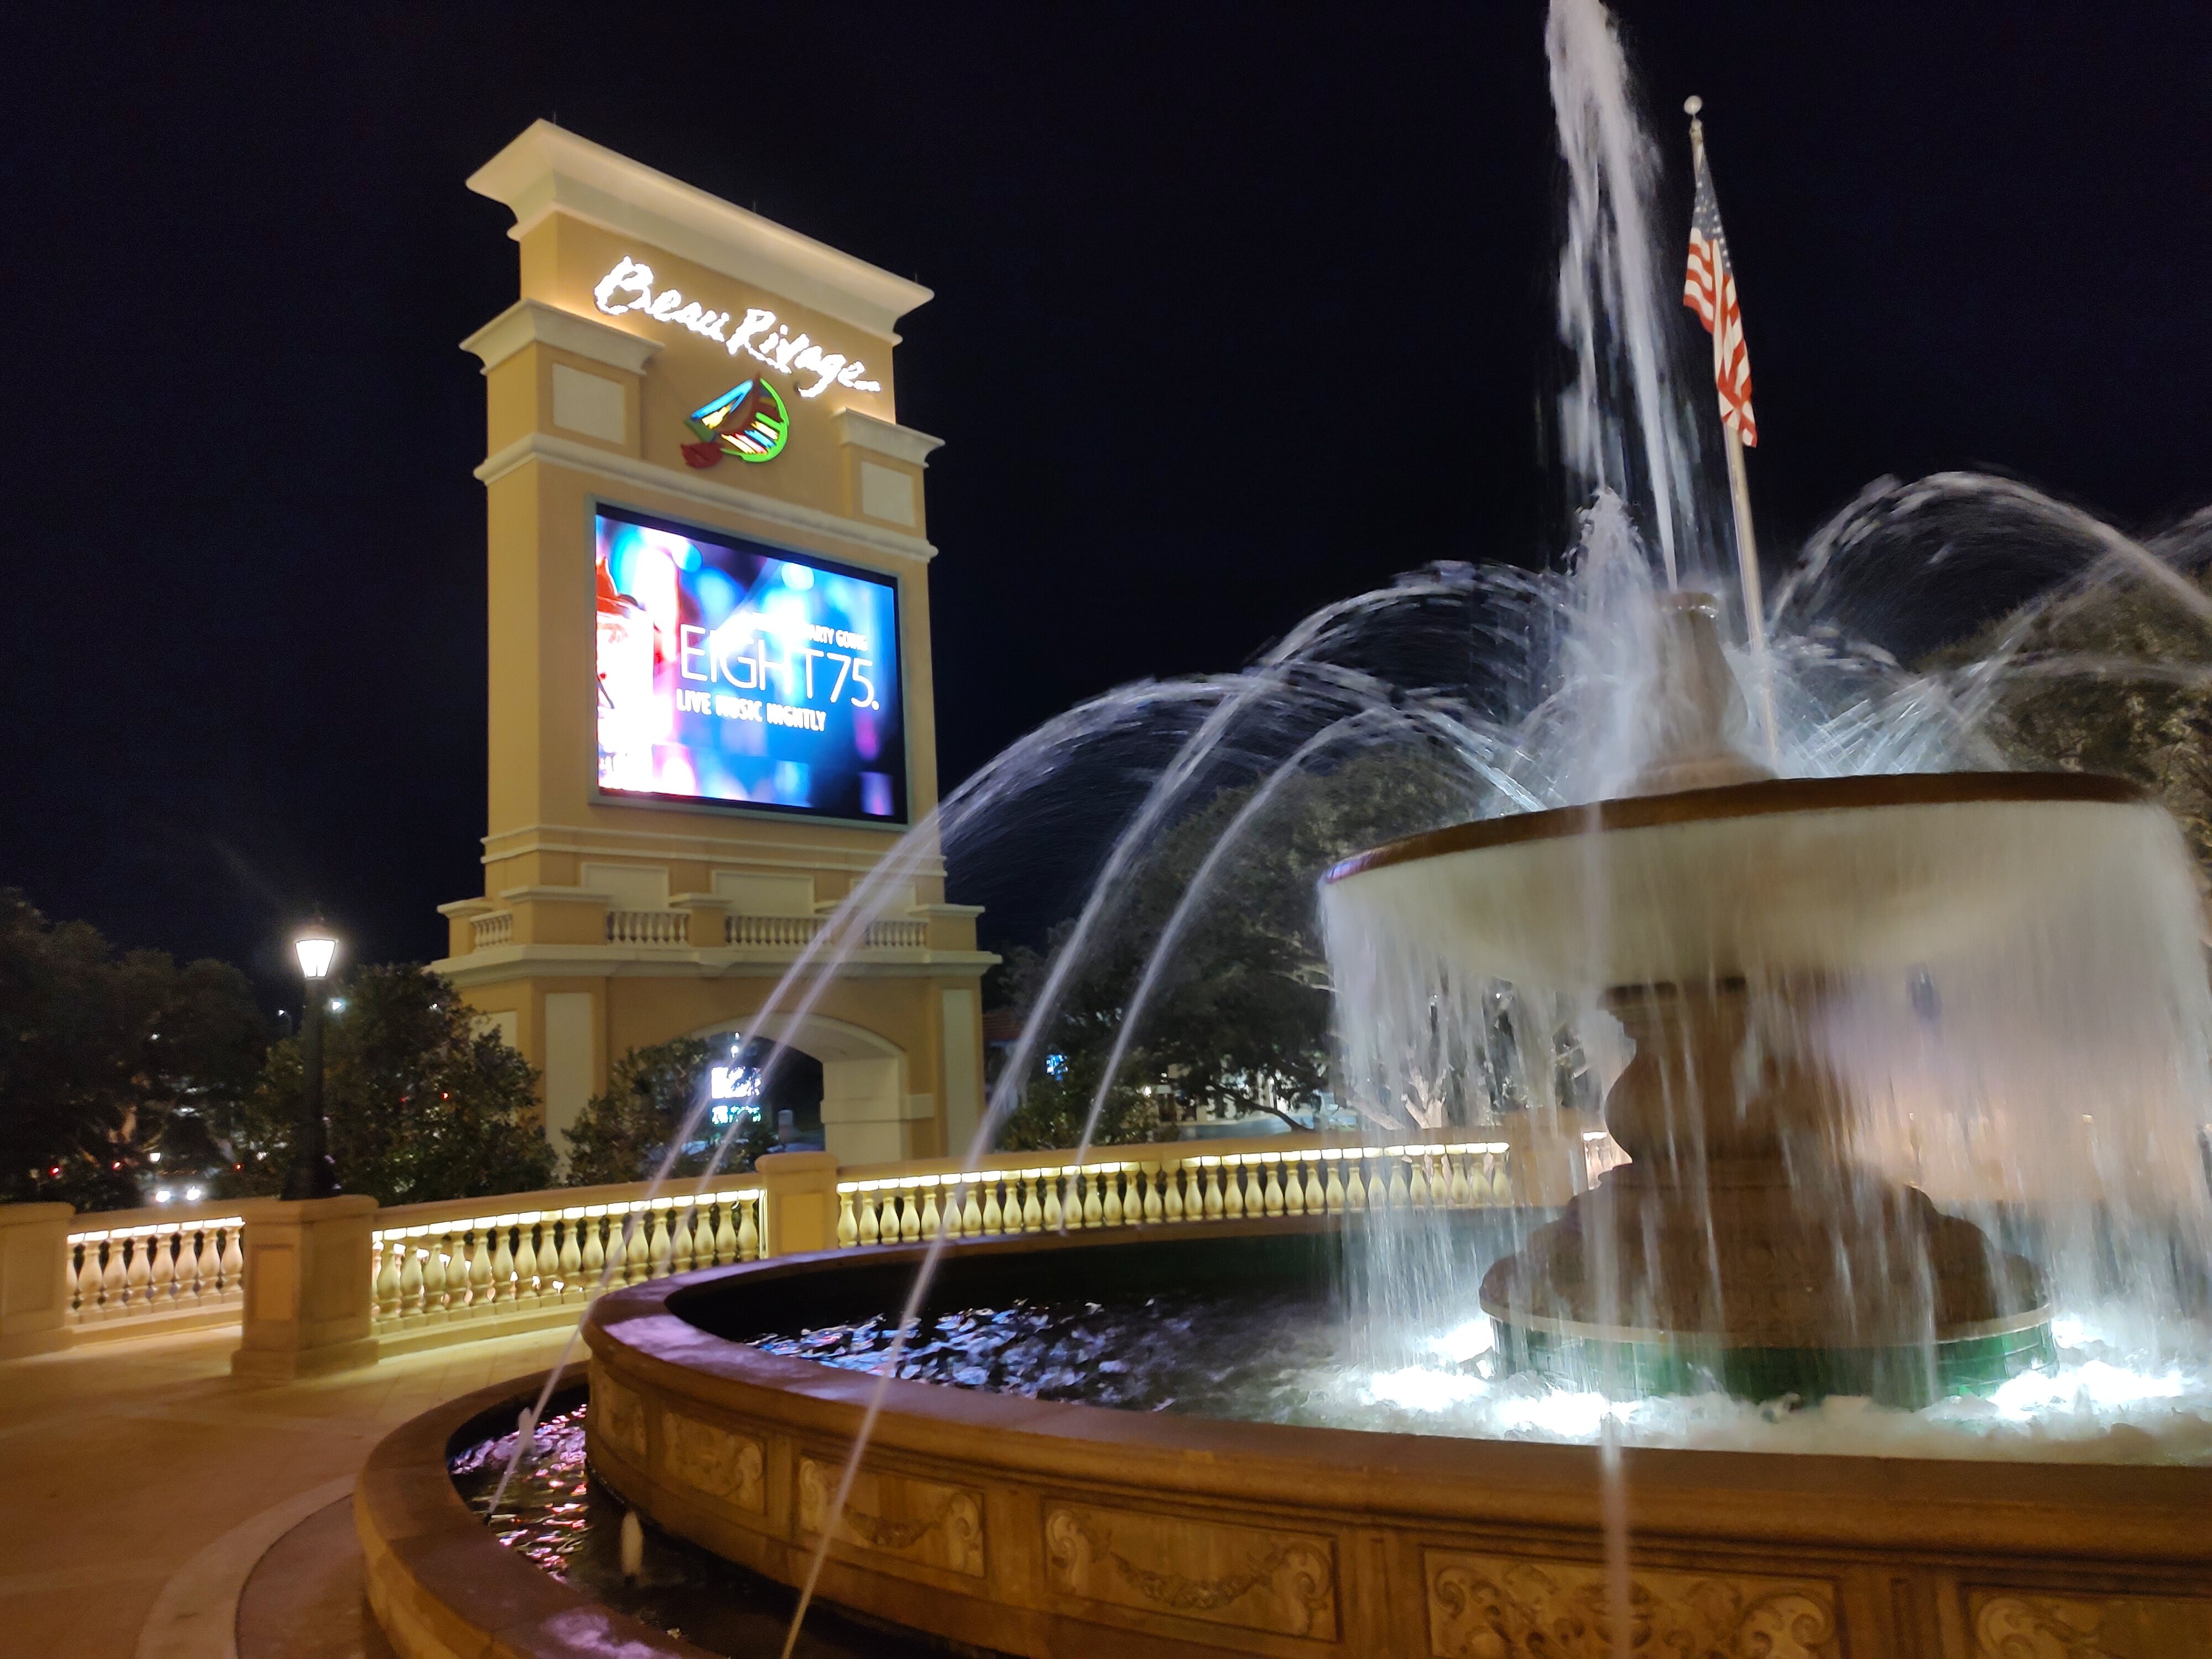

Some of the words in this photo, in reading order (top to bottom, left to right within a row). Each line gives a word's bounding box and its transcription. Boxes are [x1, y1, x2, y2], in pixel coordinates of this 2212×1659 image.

[593, 255, 729, 342] Beau
[726, 307, 880, 398] Rivage
[804, 623, 834, 645] ARTY
[676, 688, 712, 715] LIVE
[715, 693, 763, 723] MUSIC
[766, 702, 826, 732] NIGHTLY
